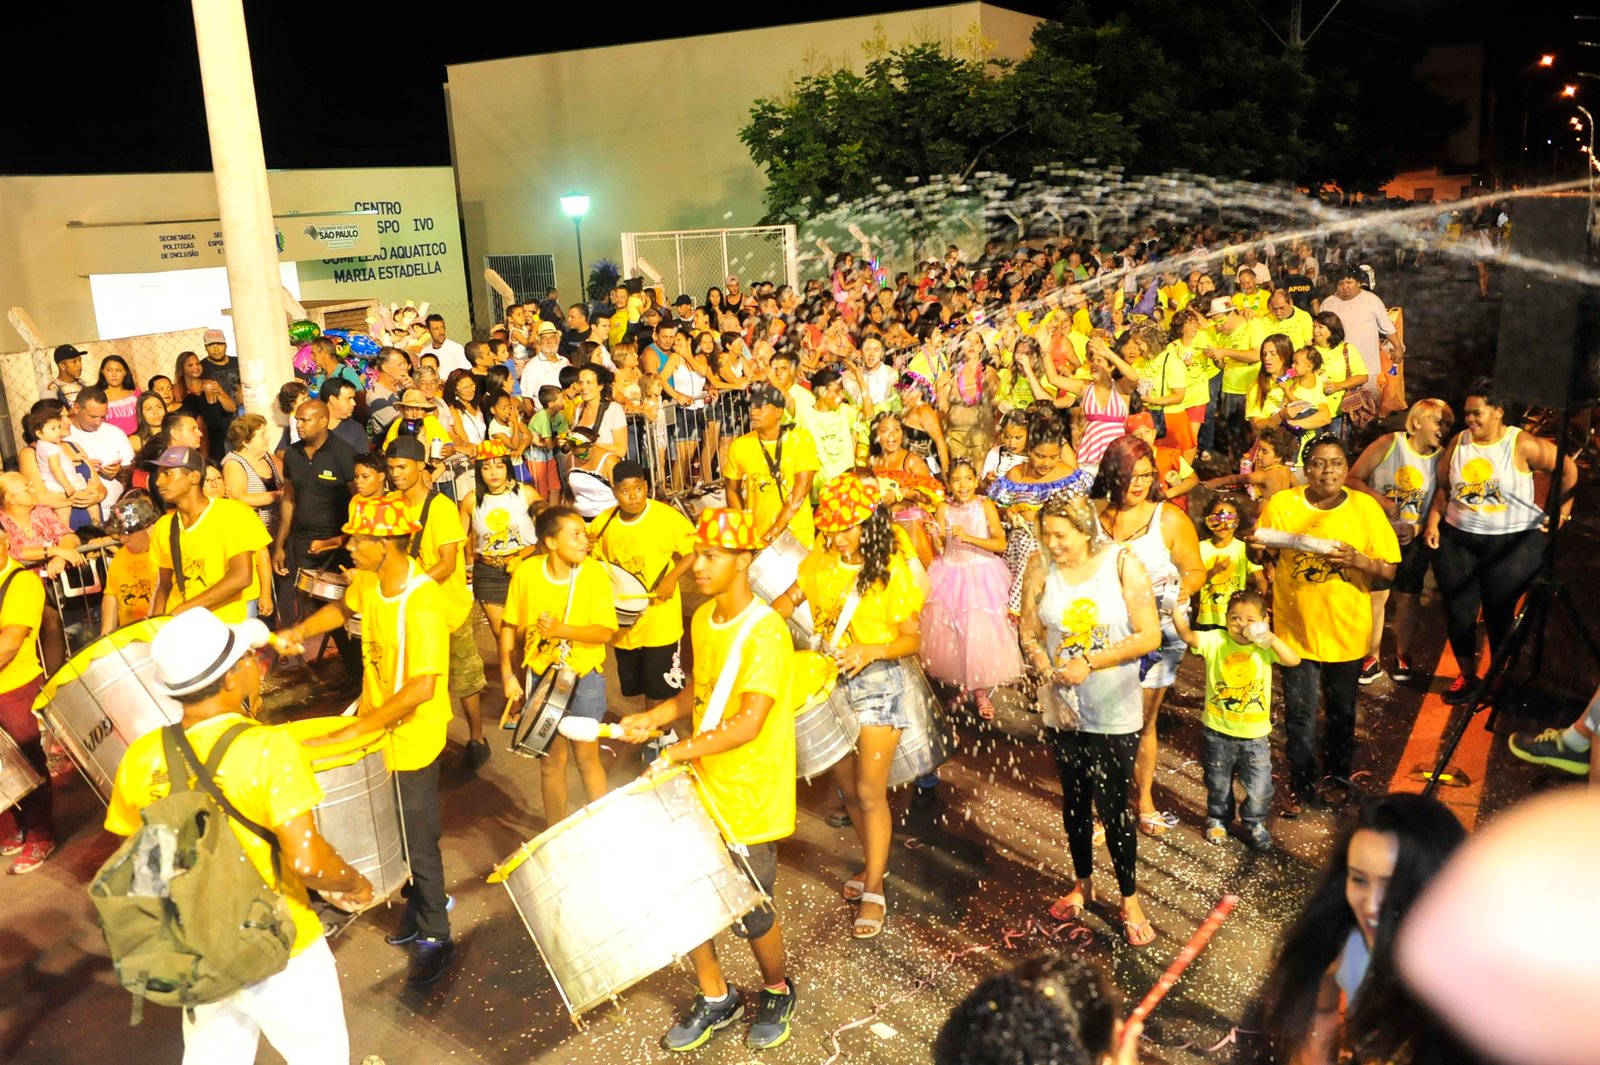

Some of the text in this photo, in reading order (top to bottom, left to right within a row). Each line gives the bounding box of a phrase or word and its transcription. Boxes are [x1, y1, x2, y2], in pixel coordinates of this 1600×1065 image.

[354, 201, 402, 215] CENTRO
[159, 233, 196, 242] SECRETARIA
[335, 229, 359, 239] PAULO
[163, 242, 195, 251] POLITICAS
[389, 242, 447, 261] AQUATICO
[333, 261, 442, 284] MARIA ESTADELLA
[1288, 285, 1311, 293] APOIO
